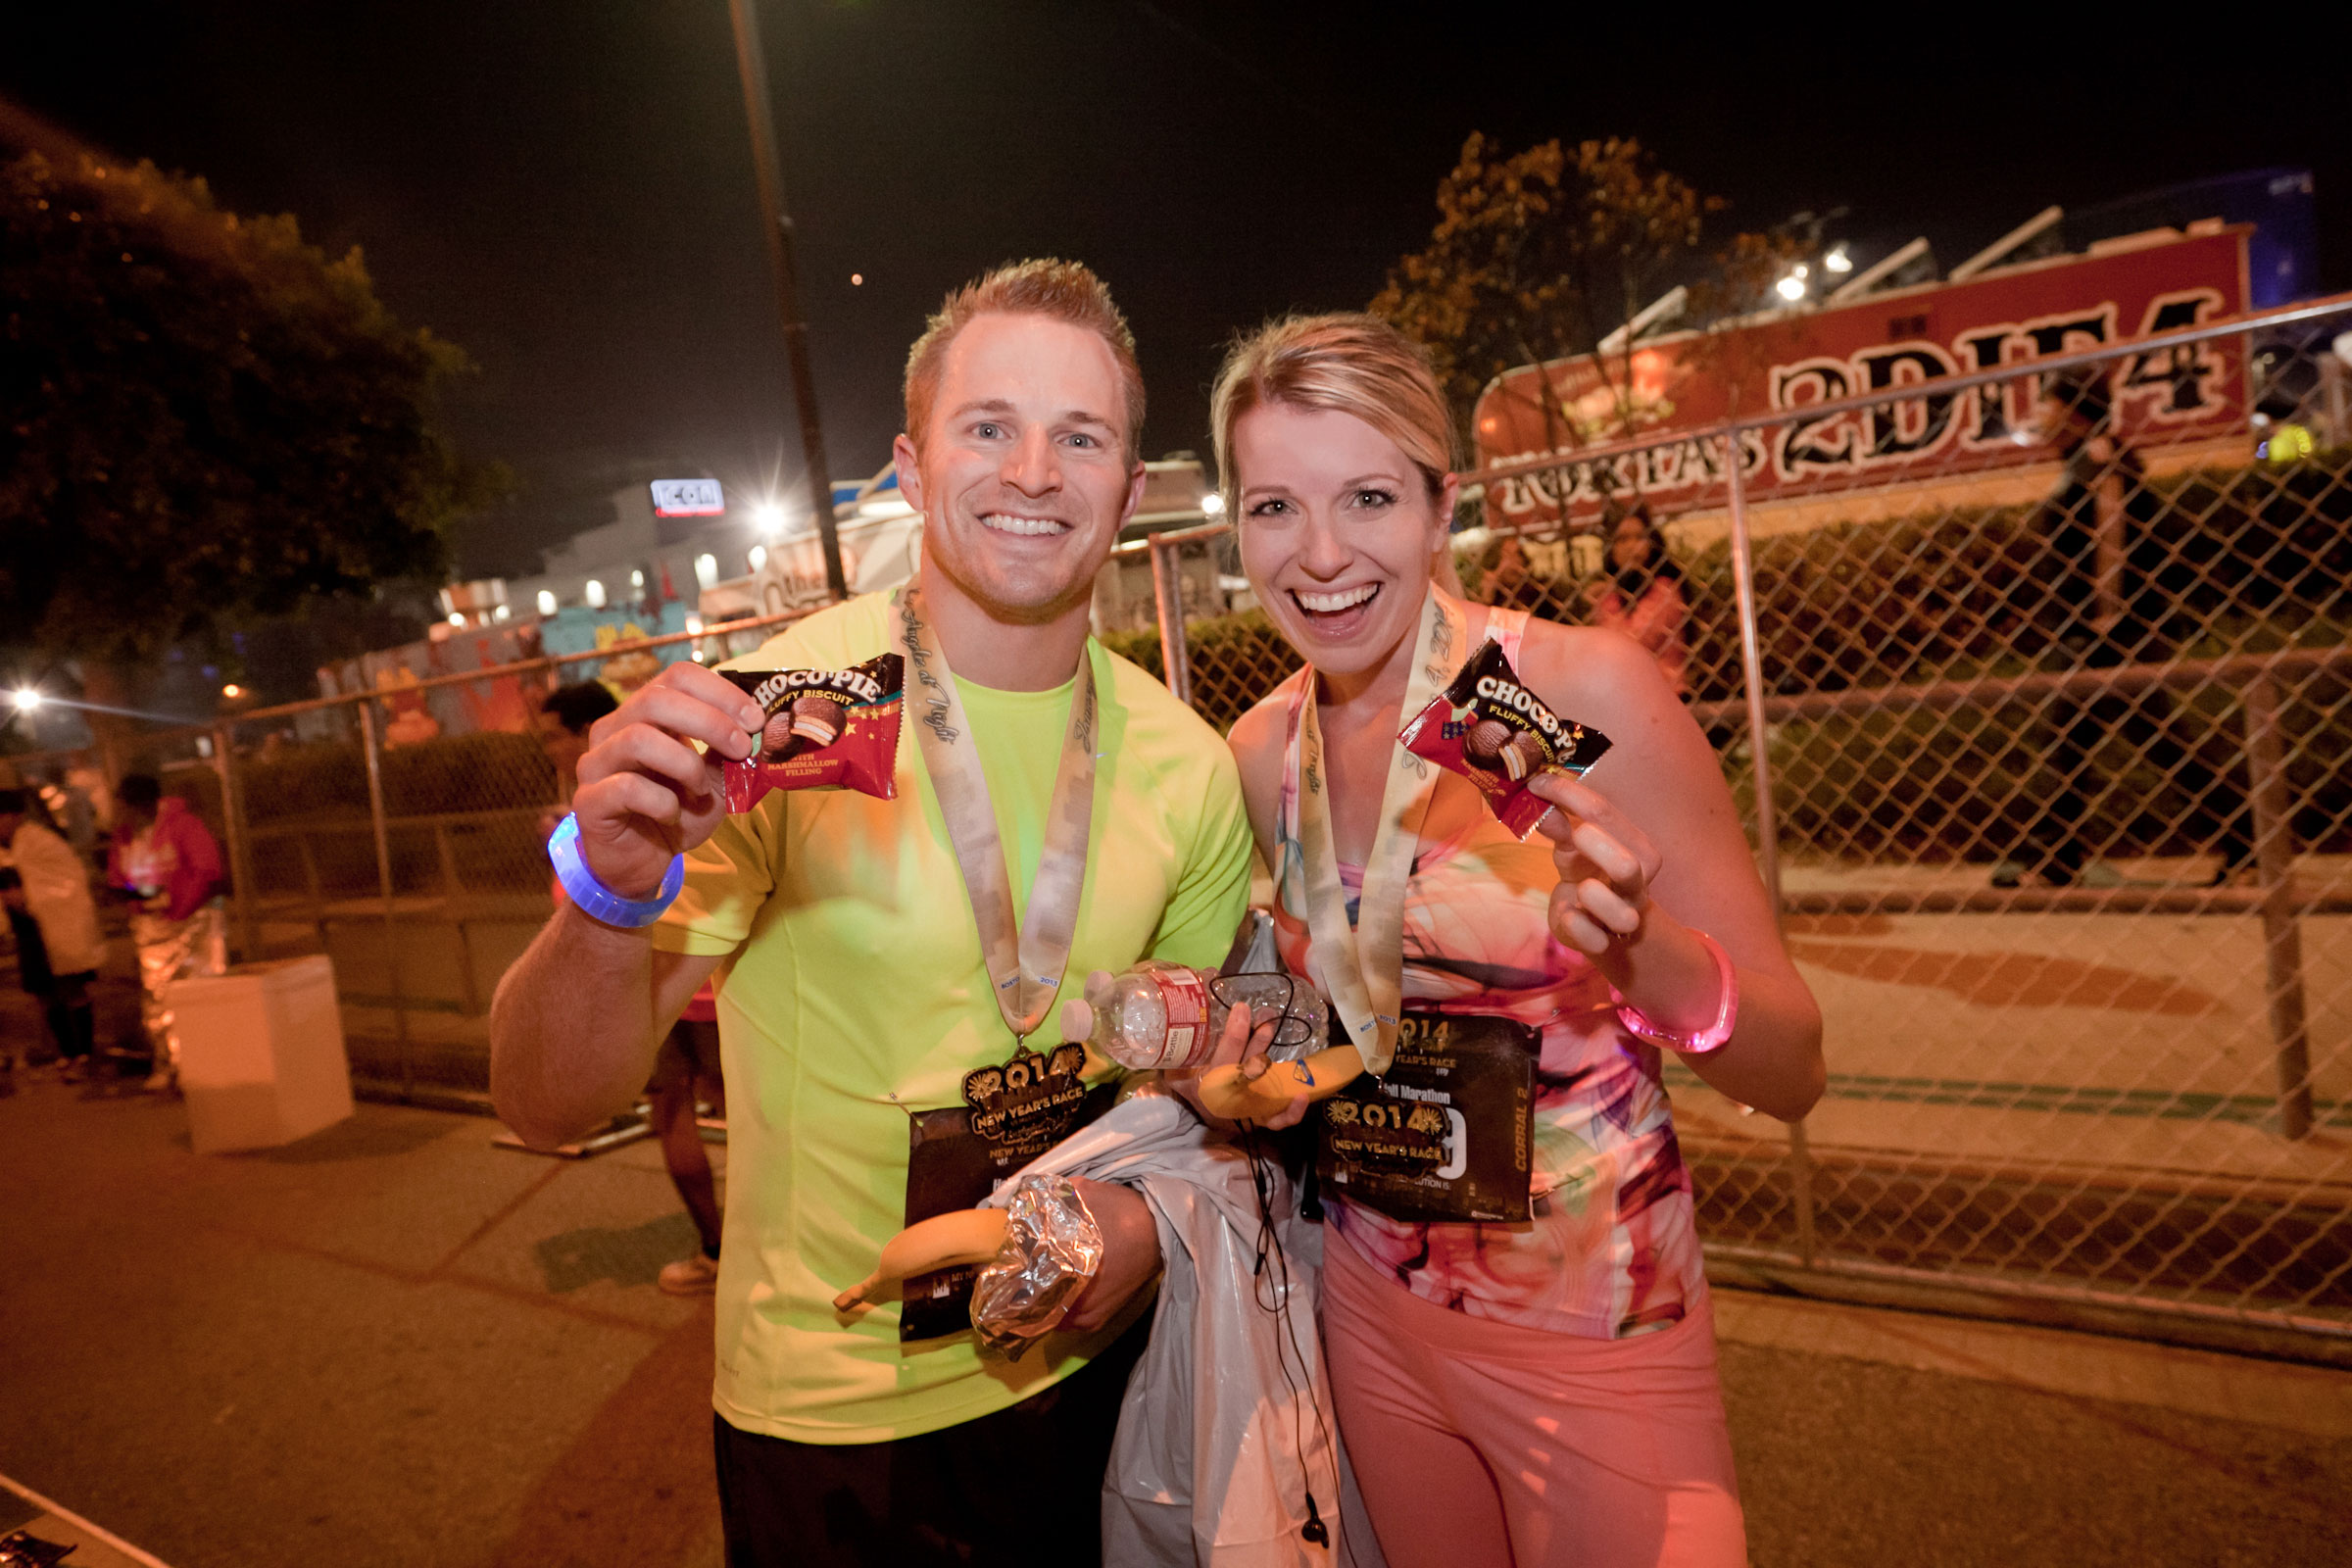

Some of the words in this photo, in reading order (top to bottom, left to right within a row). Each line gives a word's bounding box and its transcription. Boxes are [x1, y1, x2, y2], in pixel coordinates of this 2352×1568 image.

[802, 689, 855, 707] BISCUIT
[923, 683, 959, 746] Night
[1489, 704, 1531, 731] FLUFFY
[767, 759, 839, 771] MARSHMALLOW
[785, 767, 822, 777] FILLING
[1040, 976, 1058, 988] 2013
[1398, 1017, 1449, 1042] 014
[1429, 1056, 1457, 1069] RACE
[983, 1051, 1067, 1098] 2014
[1399, 1085, 1451, 1104] Marathon
[1516, 1087, 1528, 1100] 2
[976, 1111, 1006, 1130] NEW
[1008, 1096, 1051, 1119] YEAR'S
[1052, 1086, 1084, 1106] RACE
[1345, 1102, 1428, 1133] 2014
[1513, 1104, 1528, 1172] CORRAL
[989, 1148, 1013, 1159] NEW
[1016, 1142, 1052, 1156] YEAR'S
[1335, 1138, 1362, 1152] NEW
[1363, 1141, 1407, 1156] YEAR'S
[1408, 1145, 1443, 1160] RACE
